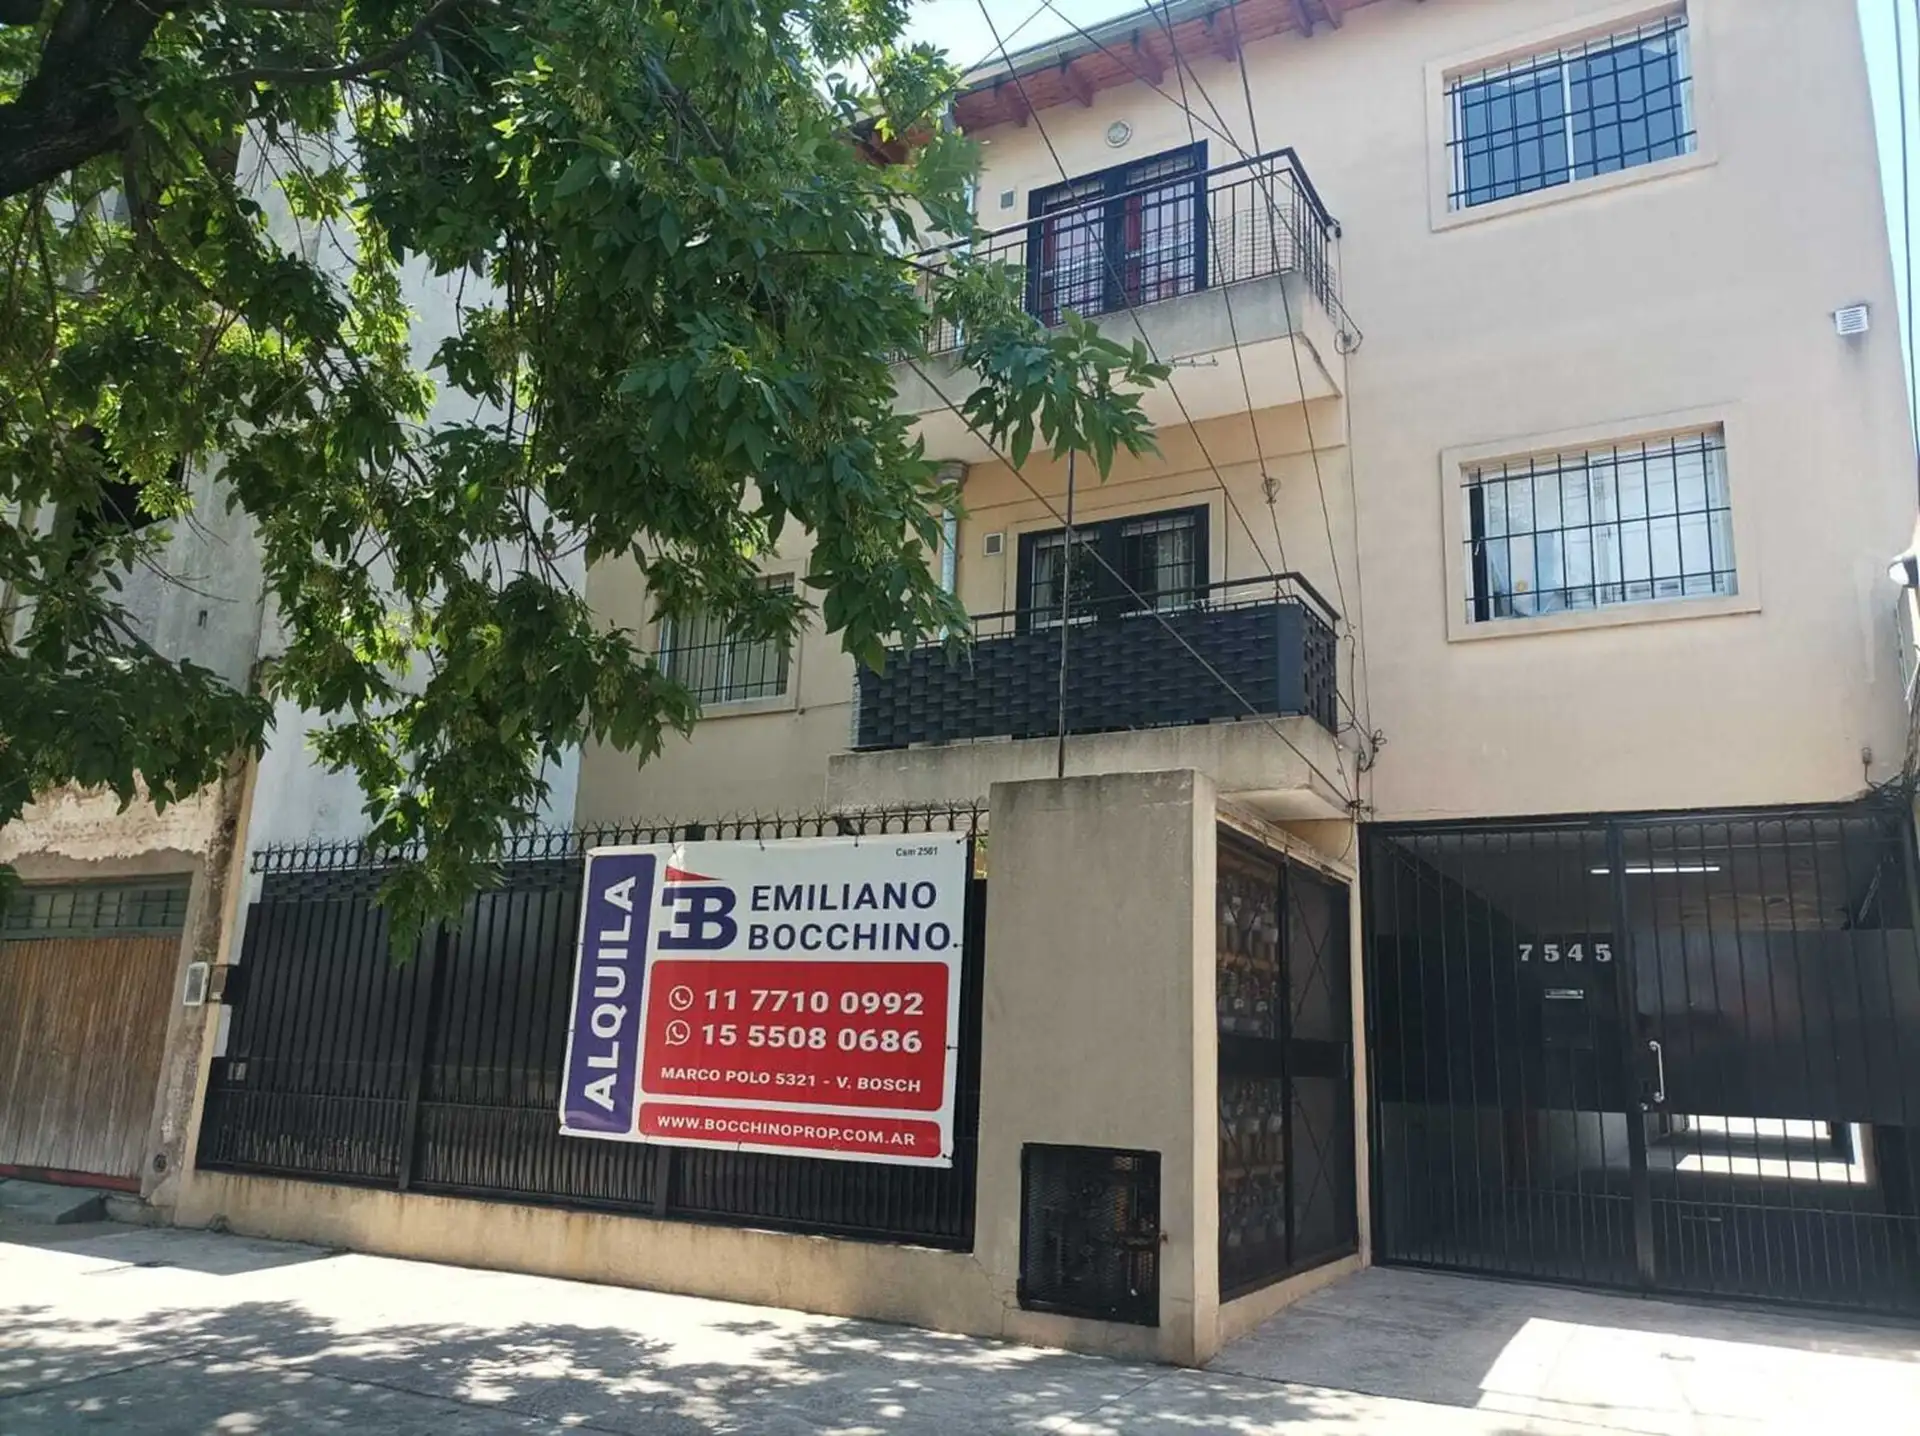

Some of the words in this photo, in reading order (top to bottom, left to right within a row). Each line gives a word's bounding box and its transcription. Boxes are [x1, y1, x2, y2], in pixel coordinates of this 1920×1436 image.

[751, 881, 937, 911] EMILIANO
[748, 922, 951, 951] BOCCHINO
[1519, 943, 1612, 962] 7545
[584, 875, 637, 1112] ALQUILA
[704, 989, 738, 1011] 11
[751, 990, 829, 1013] 7710
[840, 992, 924, 1016] 0992
[702, 1024, 737, 1046] 15
[748, 1026, 827, 1049] 5508
[838, 1029, 922, 1053] 0686
[661, 1067, 720, 1082] MARCO
[725, 1070, 770, 1085] POLO
[775, 1073, 815, 1087] 5321
[836, 1076, 851, 1090] V.
[857, 1077, 921, 1093] BOSCH
[657, 1115, 915, 1146] WWW.BOCCHINOPROP.COM.AR
